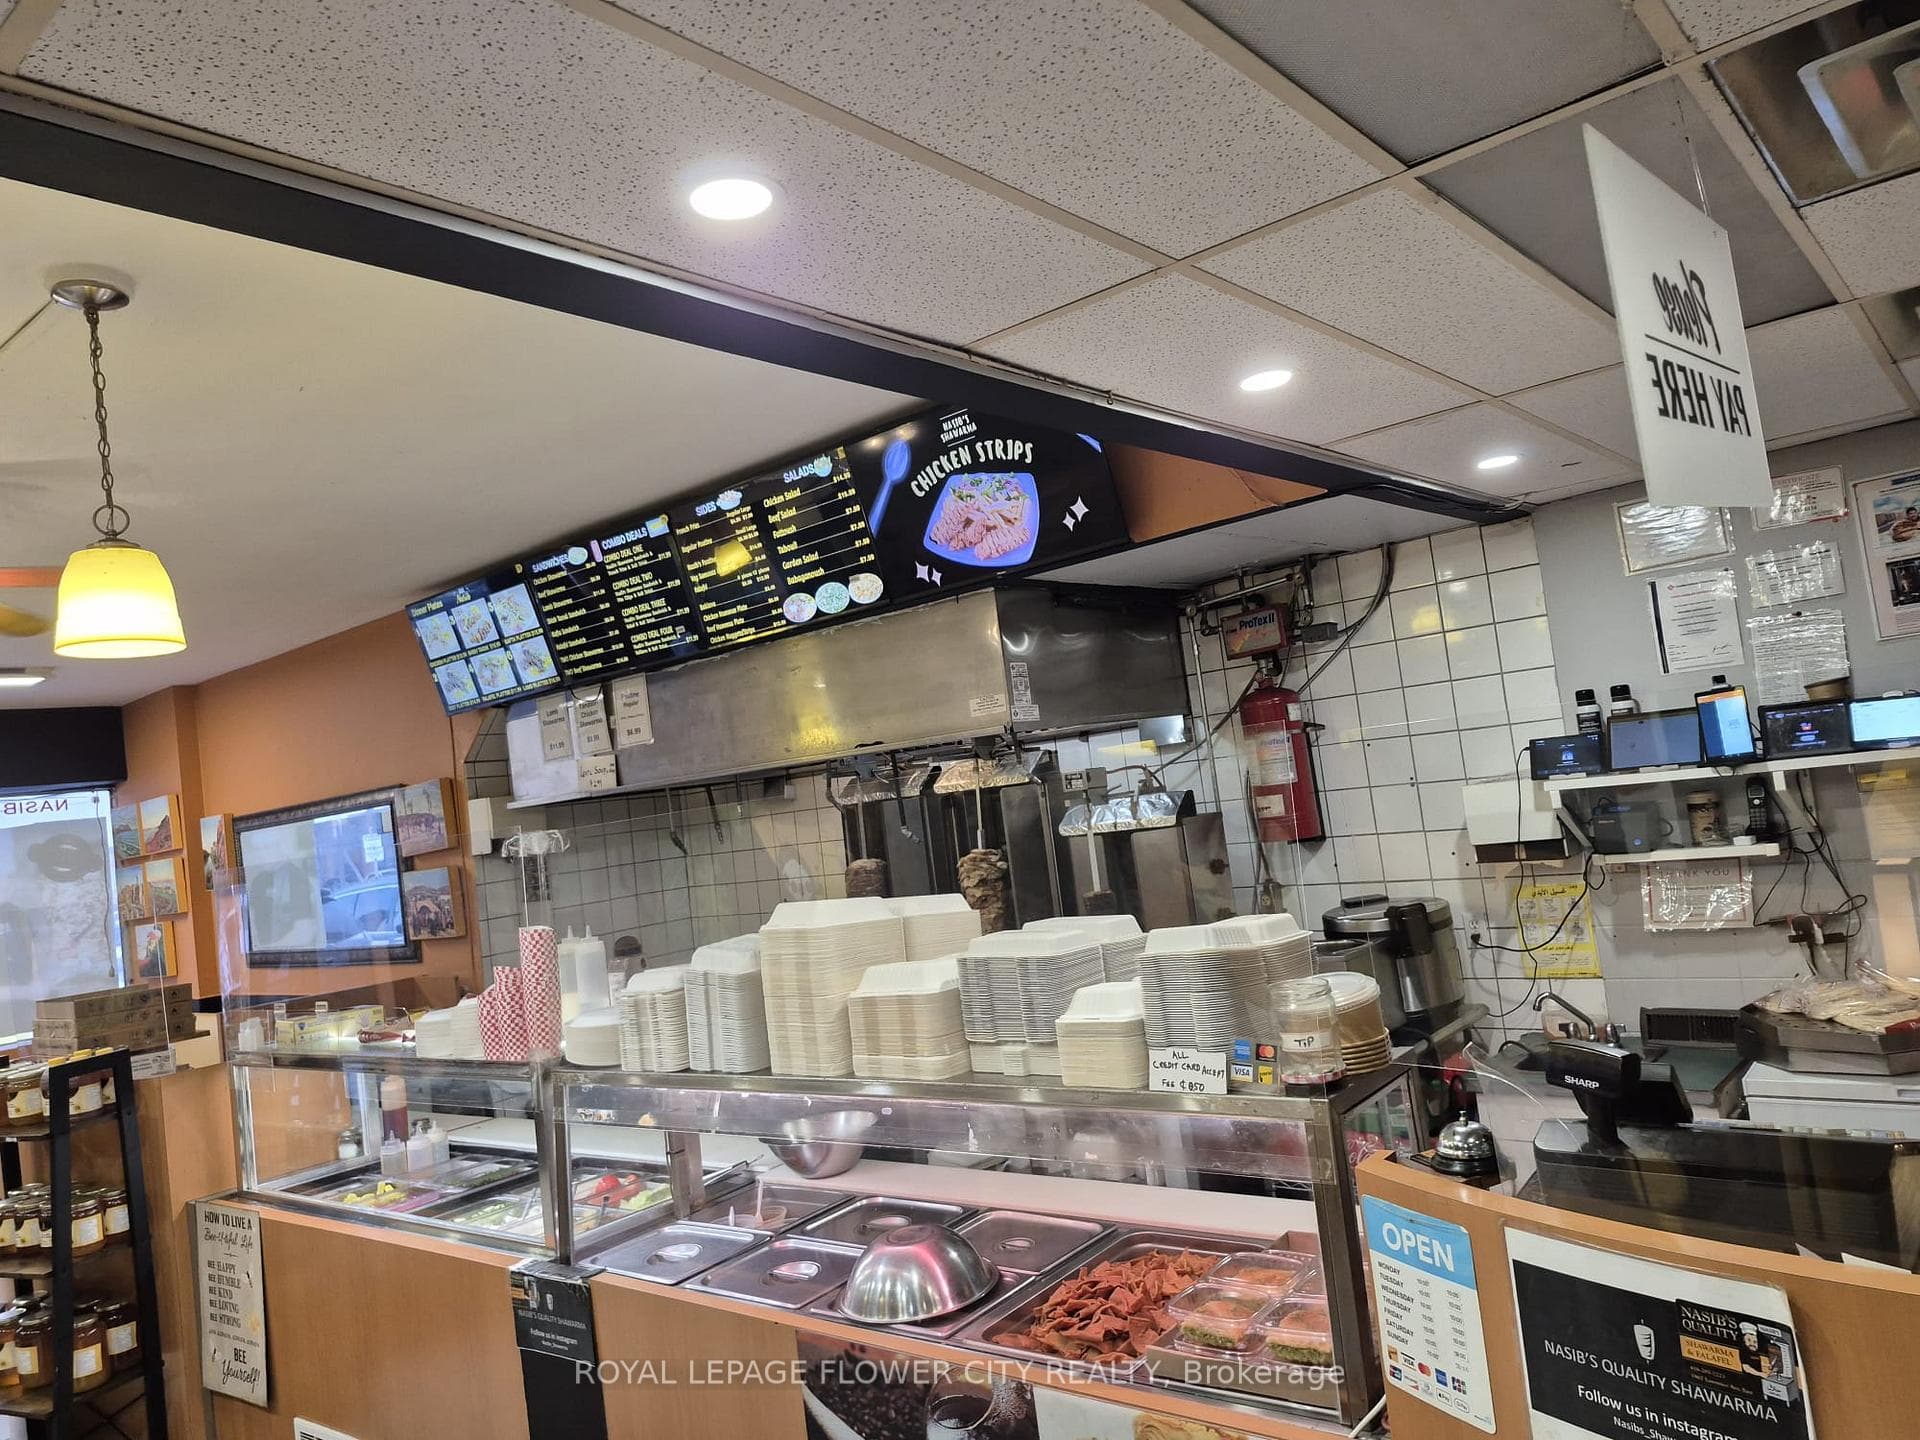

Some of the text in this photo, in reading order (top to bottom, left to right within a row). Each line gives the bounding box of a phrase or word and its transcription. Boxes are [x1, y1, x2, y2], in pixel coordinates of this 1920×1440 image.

[783, 463, 815, 483] SALADS
[910, 438, 1034, 498] CHICKEN STRIPS
[763, 494, 785, 507] Chicken
[784, 487, 801, 501] Salad
[695, 501, 717, 516] SIDES
[768, 506, 797, 524] Beef Salad
[601, 527, 648, 550] COMBO DEALS
[604, 544, 644, 564] COMBO DEAL ONE
[782, 558, 802, 570] Garden
[802, 551, 819, 564] Salad
[532, 553, 569, 574] SANDWICHES
[612, 571, 653, 591] COMBO DEAL TWO
[622, 598, 666, 616] COMBO DEAL THREE
[630, 626, 674, 644] COMBO DEAL FOUR
[1172, 1050, 1190, 1060] ALL
[1181, 1062, 1201, 1072] CARD
[1234, 1067, 1250, 1076] VISA
[1564, 1074, 1600, 1089] SHARP
[204, 1210, 253, 1231] HOW TO LIVE A
[1382, 1222, 1455, 1272] OPEN
[208, 1260, 236, 1275] BEE HAPPY
[1378, 1261, 1400, 1275] MONDAY
[208, 1273, 216, 1282] BEE
[1380, 1272, 1404, 1288] TUESDAY
[208, 1286, 234, 1300] BEE KIND
[1381, 1285, 1414, 1304] WEDNESDAY
[218, 1299, 240, 1314] LOVING
[1382, 1295, 1411, 1313] THURSDAY
[210, 1312, 242, 1328] BEE STRONG
[1384, 1306, 1403, 1321] FRIDAY
[1681, 1306, 1738, 1329] NASIB'S
[1386, 1318, 1414, 1337] SATURDAY
[1682, 1318, 1738, 1341] QUALITY
[1386, 1330, 1408, 1345] SUNDAY
[234, 1347, 247, 1364] BEE
[1685, 1340, 1735, 1358] SHAWARMA
[1696, 1350, 1732, 1366] FALAFEL
[1544, 1339, 1599, 1368] NASIB'S
[1601, 1359, 1666, 1390] QUALITY
[1671, 1380, 1778, 1424] SHAWARMA
[1578, 1385, 1622, 1410] Follow
[1626, 1404, 1642, 1418] us
[1645, 1406, 1659, 1424] in
